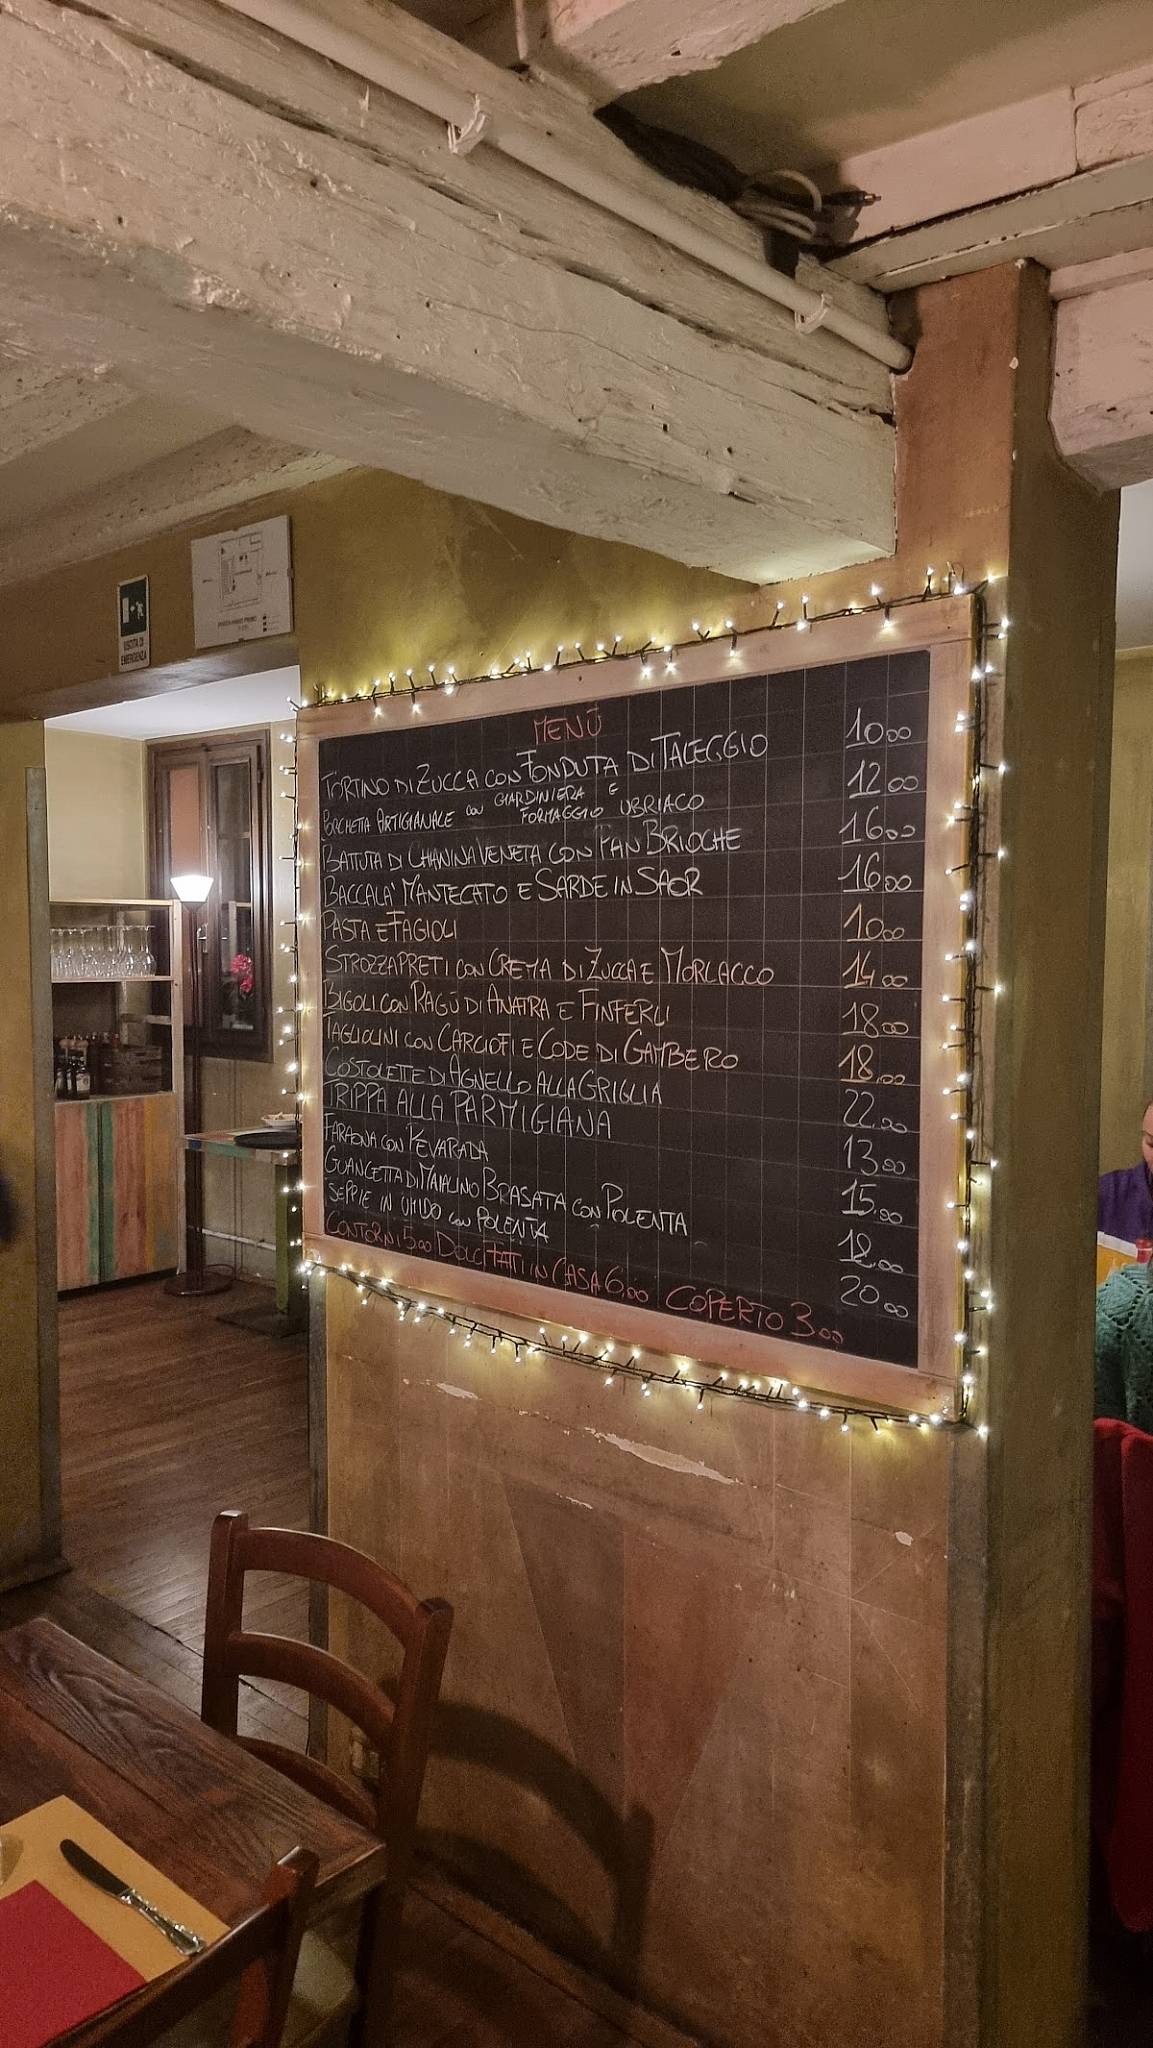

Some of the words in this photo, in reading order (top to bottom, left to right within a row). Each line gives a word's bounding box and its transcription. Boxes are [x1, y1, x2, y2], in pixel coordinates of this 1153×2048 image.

[321, 771, 390, 803] TORTINO
[395, 778, 414, 794] DI
[416, 763, 481, 796] ZUCCA
[484, 769, 522, 788] CON
[516, 750, 619, 784] FONDUTA
[627, 751, 654, 773] DI
[651, 730, 769, 771] TALEGGIO
[322, 808, 371, 837] PORCHETTA
[376, 807, 456, 834] ARTIGIANALE
[494, 784, 586, 809] GIARDINIERA
[608, 782, 619, 796] E
[519, 804, 604, 825] FORMAGGIO
[620, 793, 705, 819] UBRIACO
[321, 843, 383, 874] BATTUTA
[388, 852, 403, 872] DI
[476, 836, 542, 867] VENETA
[548, 842, 593, 865] CON
[599, 824, 641, 861] PAN
[642, 818, 743, 856] BRIOCHE
[402, 873, 508, 907] MANTECATO
[517, 882, 534, 901] E
[535, 867, 609, 902] SARDE
[613, 876, 634, 896] IN
[635, 866, 704, 898] SAOR
[320, 908, 371, 943] PASTA
[375, 923, 390, 943] E
[385, 909, 457, 943] FAGIOLI
[324, 945, 449, 977] STROZZAPRETI
[456, 959, 485, 981] CON
[488, 947, 552, 981] CREMA
[562, 958, 584, 982] DI
[584, 946, 638, 979] ZUCCA
[641, 961, 655, 985] E
[660, 945, 775, 986] MORLACCO
[323, 979, 376, 1014] BIGOLI
[380, 993, 409, 1014] CON
[463, 996, 483, 1016] DI
[487, 983, 550, 1022] ANATRA
[556, 1001, 575, 1021] E
[578, 988, 671, 1027] FINFERLI
[322, 1011, 399, 1049] TAGLIOLINI
[404, 1031, 434, 1051] CON
[437, 1022, 516, 1057] CARCIOFI
[521, 1038, 535, 1059] E
[537, 1027, 590, 1062] CODE
[597, 1042, 619, 1064] DI
[623, 1028, 739, 1072] GAMBERO
[324, 1046, 426, 1085] COSTOLETTE
[428, 1066, 447, 1087] DI
[449, 1053, 533, 1096] AGNELLO
[537, 1070, 577, 1100] ALLA
[577, 1068, 663, 1106] GRIGLIA
[322, 1078, 388, 1115] TRIPPA
[397, 1088, 445, 1122] ALLA
[450, 1089, 612, 1141] PARMIGIANA
[323, 1112, 378, 1149] FARAONA
[381, 1134, 405, 1154] CON
[324, 1145, 403, 1185] GUANCETTA
[405, 1169, 420, 1189] DI
[419, 1161, 481, 1199] MAIALINO
[483, 1166, 568, 1213] BRASATA
[572, 1196, 601, 1219] CON
[601, 1182, 689, 1237] POLENTA
[328, 1179, 374, 1210] SEPPIE
[380, 1191, 393, 1214] IN
[401, 1193, 443, 1221] UMIDO
[477, 1206, 550, 1245] POLENTA
[326, 1209, 401, 1249] CONTORNI
[436, 1231, 487, 1266] DOLCI
[485, 1240, 526, 1276] FATTI
[530, 1265, 549, 1280] IN
[552, 1257, 601, 1295] CASA
[665, 1285, 784, 1332] COPERTO
